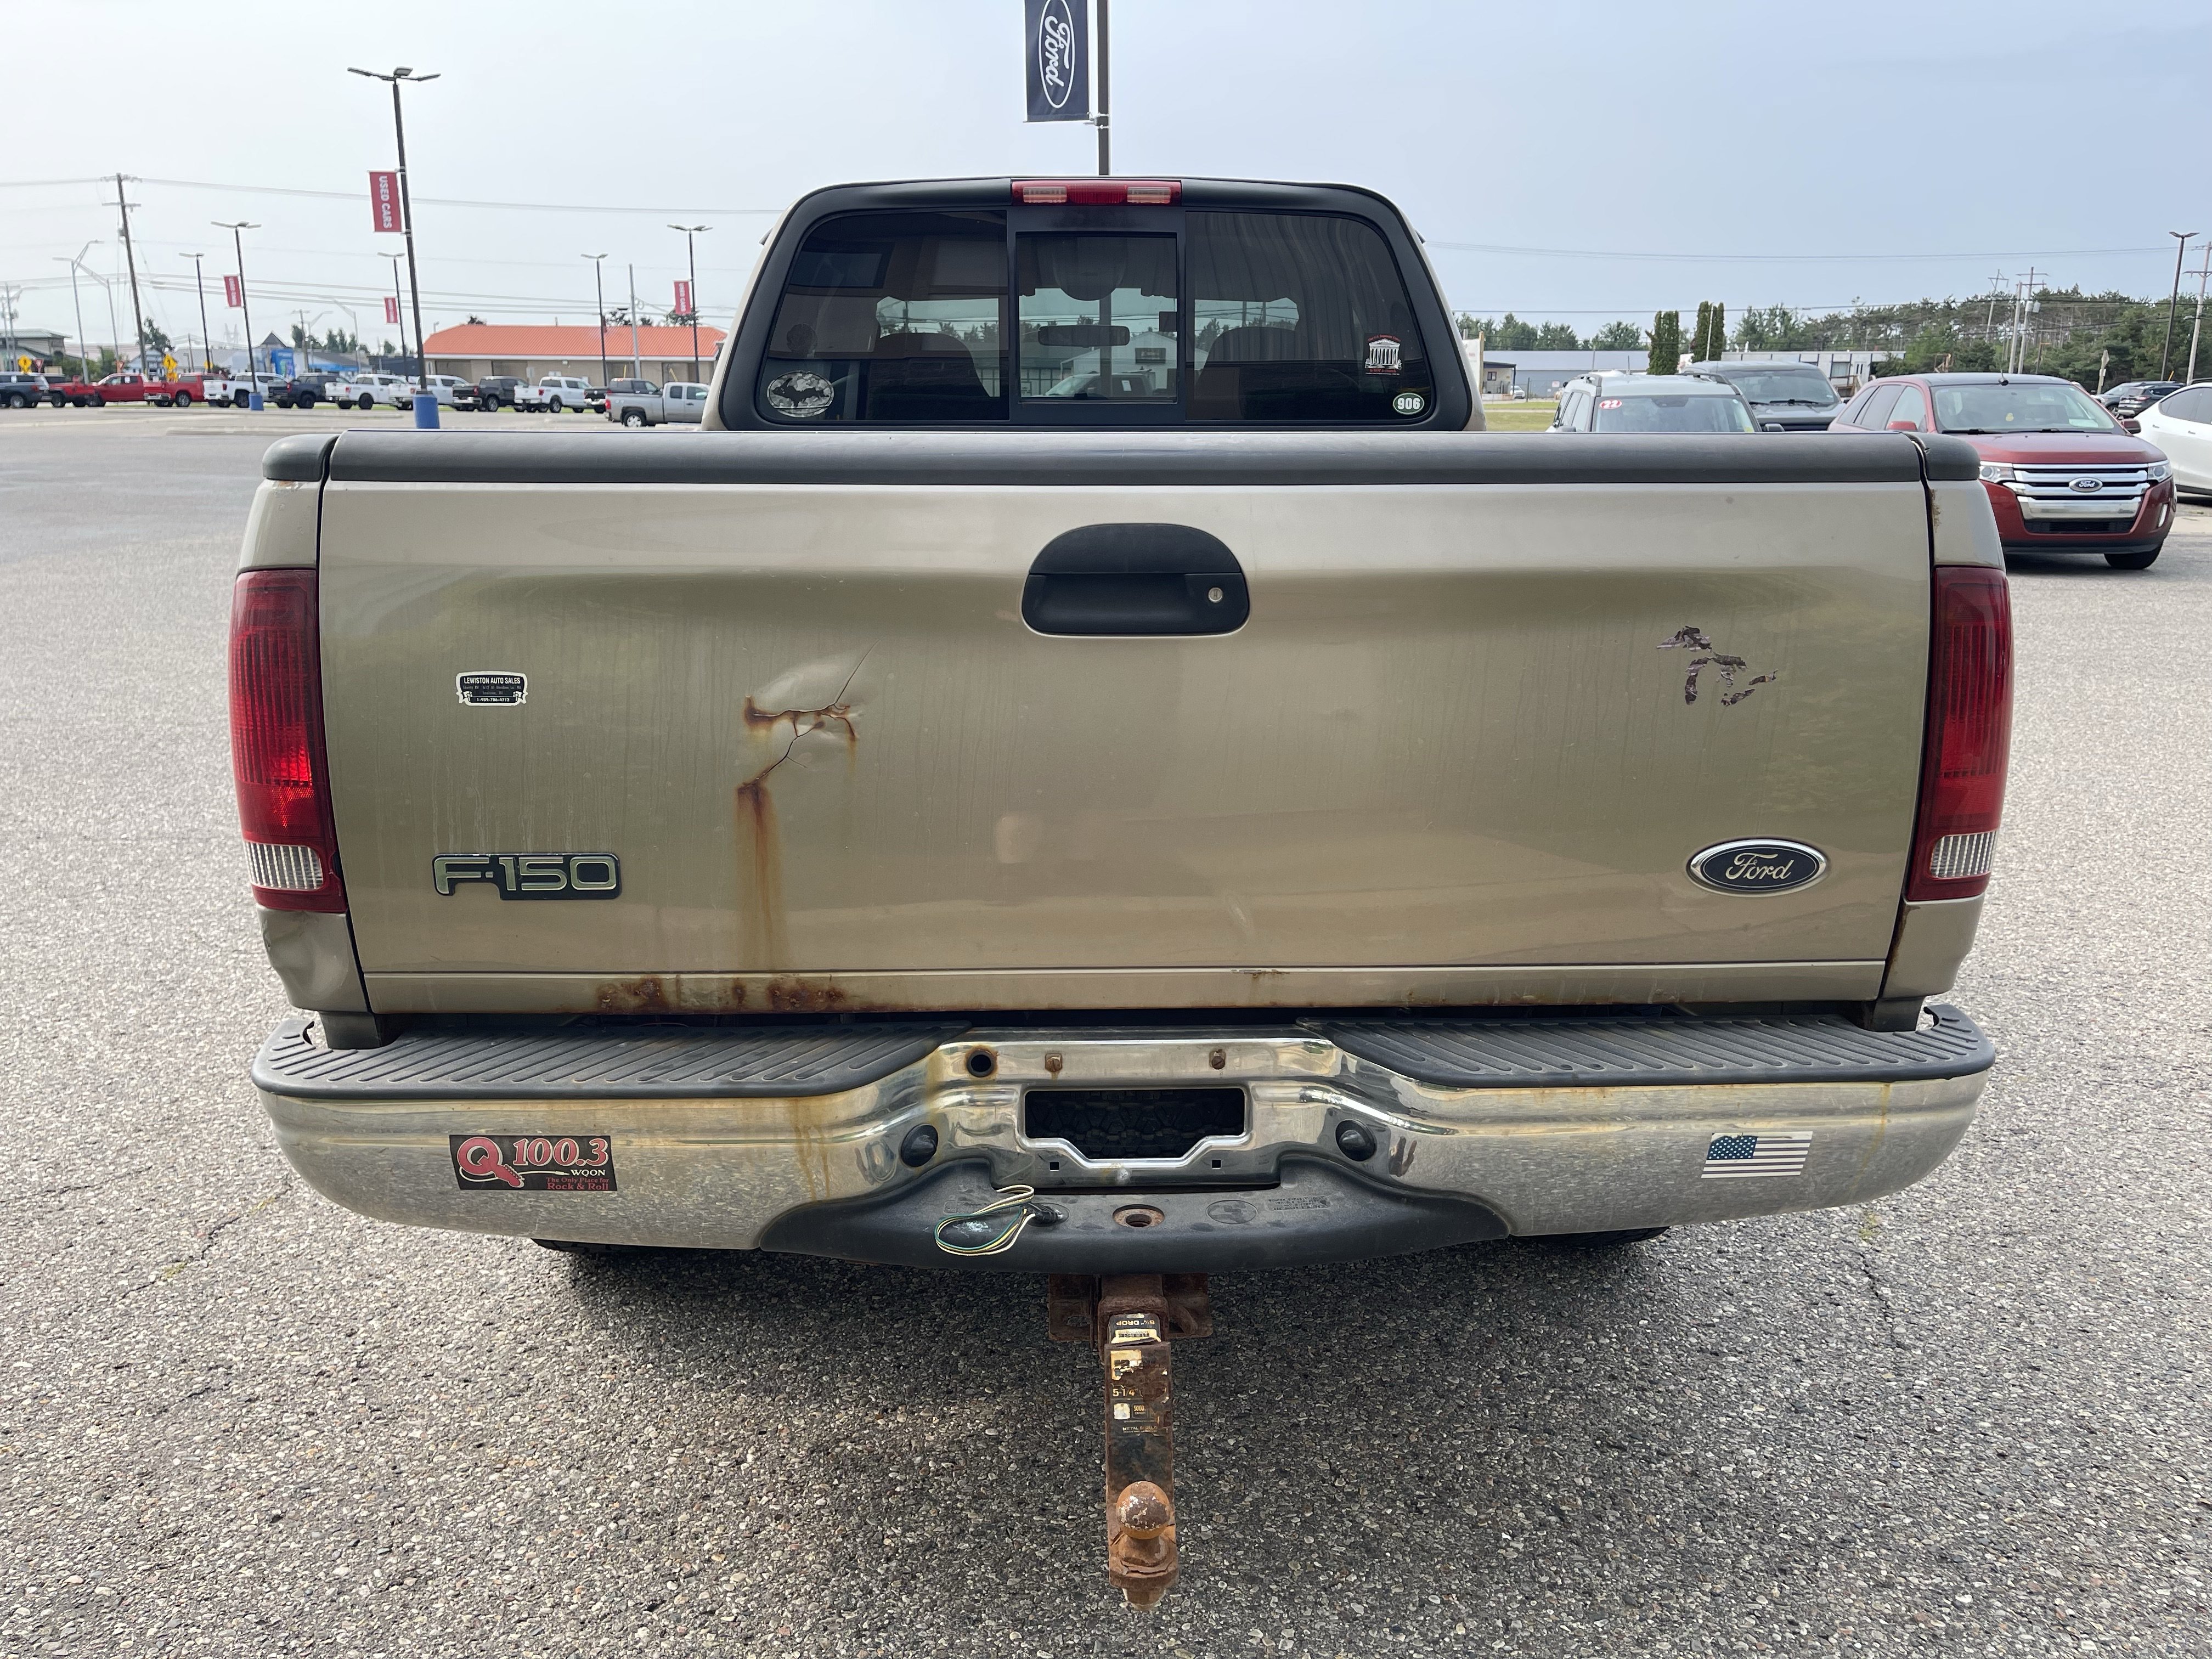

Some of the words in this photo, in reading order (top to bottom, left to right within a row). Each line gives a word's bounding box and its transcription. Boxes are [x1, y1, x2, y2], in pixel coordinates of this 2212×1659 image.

[1044, 15, 1070, 87] Ford
[379, 175, 390, 202] USED
[381, 202, 393, 229] CARS
[1397, 397, 1420, 410] 906
[434, 856, 617, 894] F-150
[1725, 852, 1795, 879] Ford
[457, 1137, 525, 1188] Q
[513, 1138, 609, 1166] 100.3
